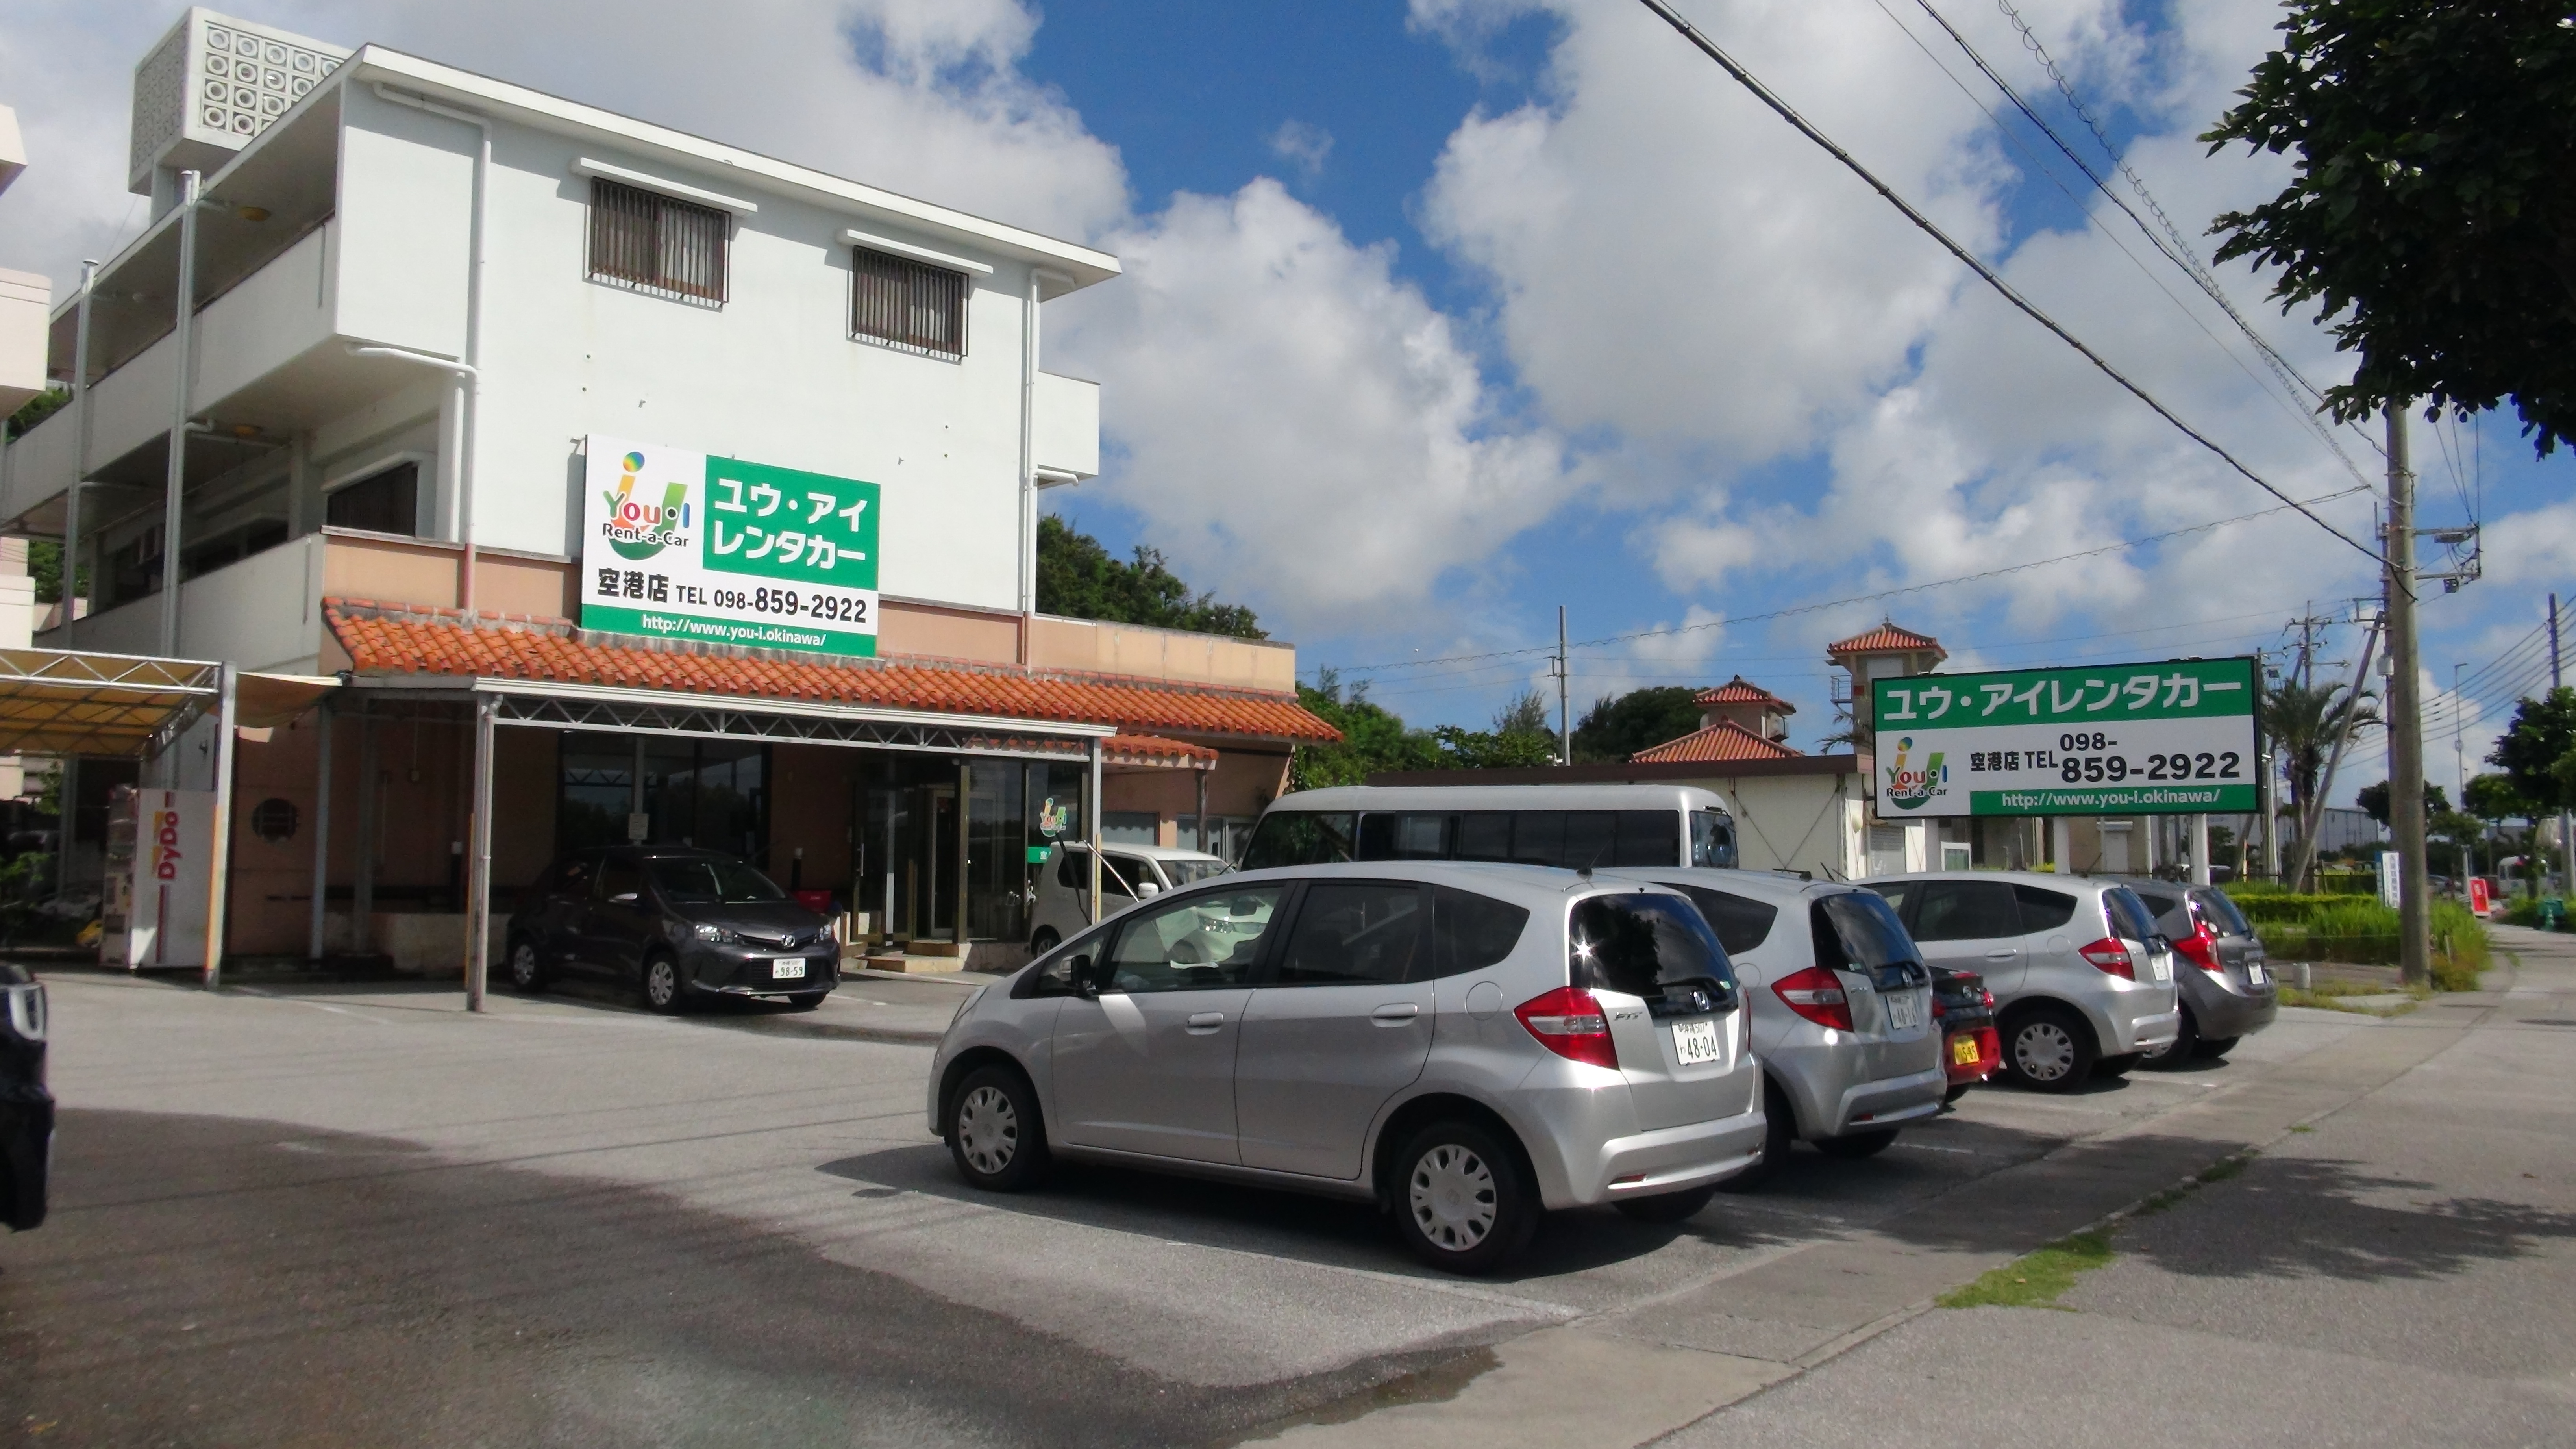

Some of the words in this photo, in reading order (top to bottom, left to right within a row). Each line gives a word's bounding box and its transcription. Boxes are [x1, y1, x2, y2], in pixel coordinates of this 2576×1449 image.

[714, 478, 868, 532] ユウ・アイ
[602, 523, 689, 547] Rent-a-Car
[714, 520, 866, 569] レンタカー
[597, 567, 670, 604] 空港店
[675, 584, 708, 606] TEL
[714, 587, 867, 624] 098-859-2922
[642, 613, 827, 647] http://www.you-i.okinawa/
[1884, 673, 2241, 720] ユウ・アイレンタカー
[2060, 732, 2118, 752] 098-
[1970, 751, 2020, 772] 空港店
[2024, 750, 2058, 769] TEL
[2061, 752, 2240, 783] 859-2922
[1886, 787, 1948, 797] Rent-a-Car
[2002, 788, 2221, 809] http://www.you-i.okinawa/
[158, 812, 183, 880] DyDo
[780, 966, 803, 976] 98-59
